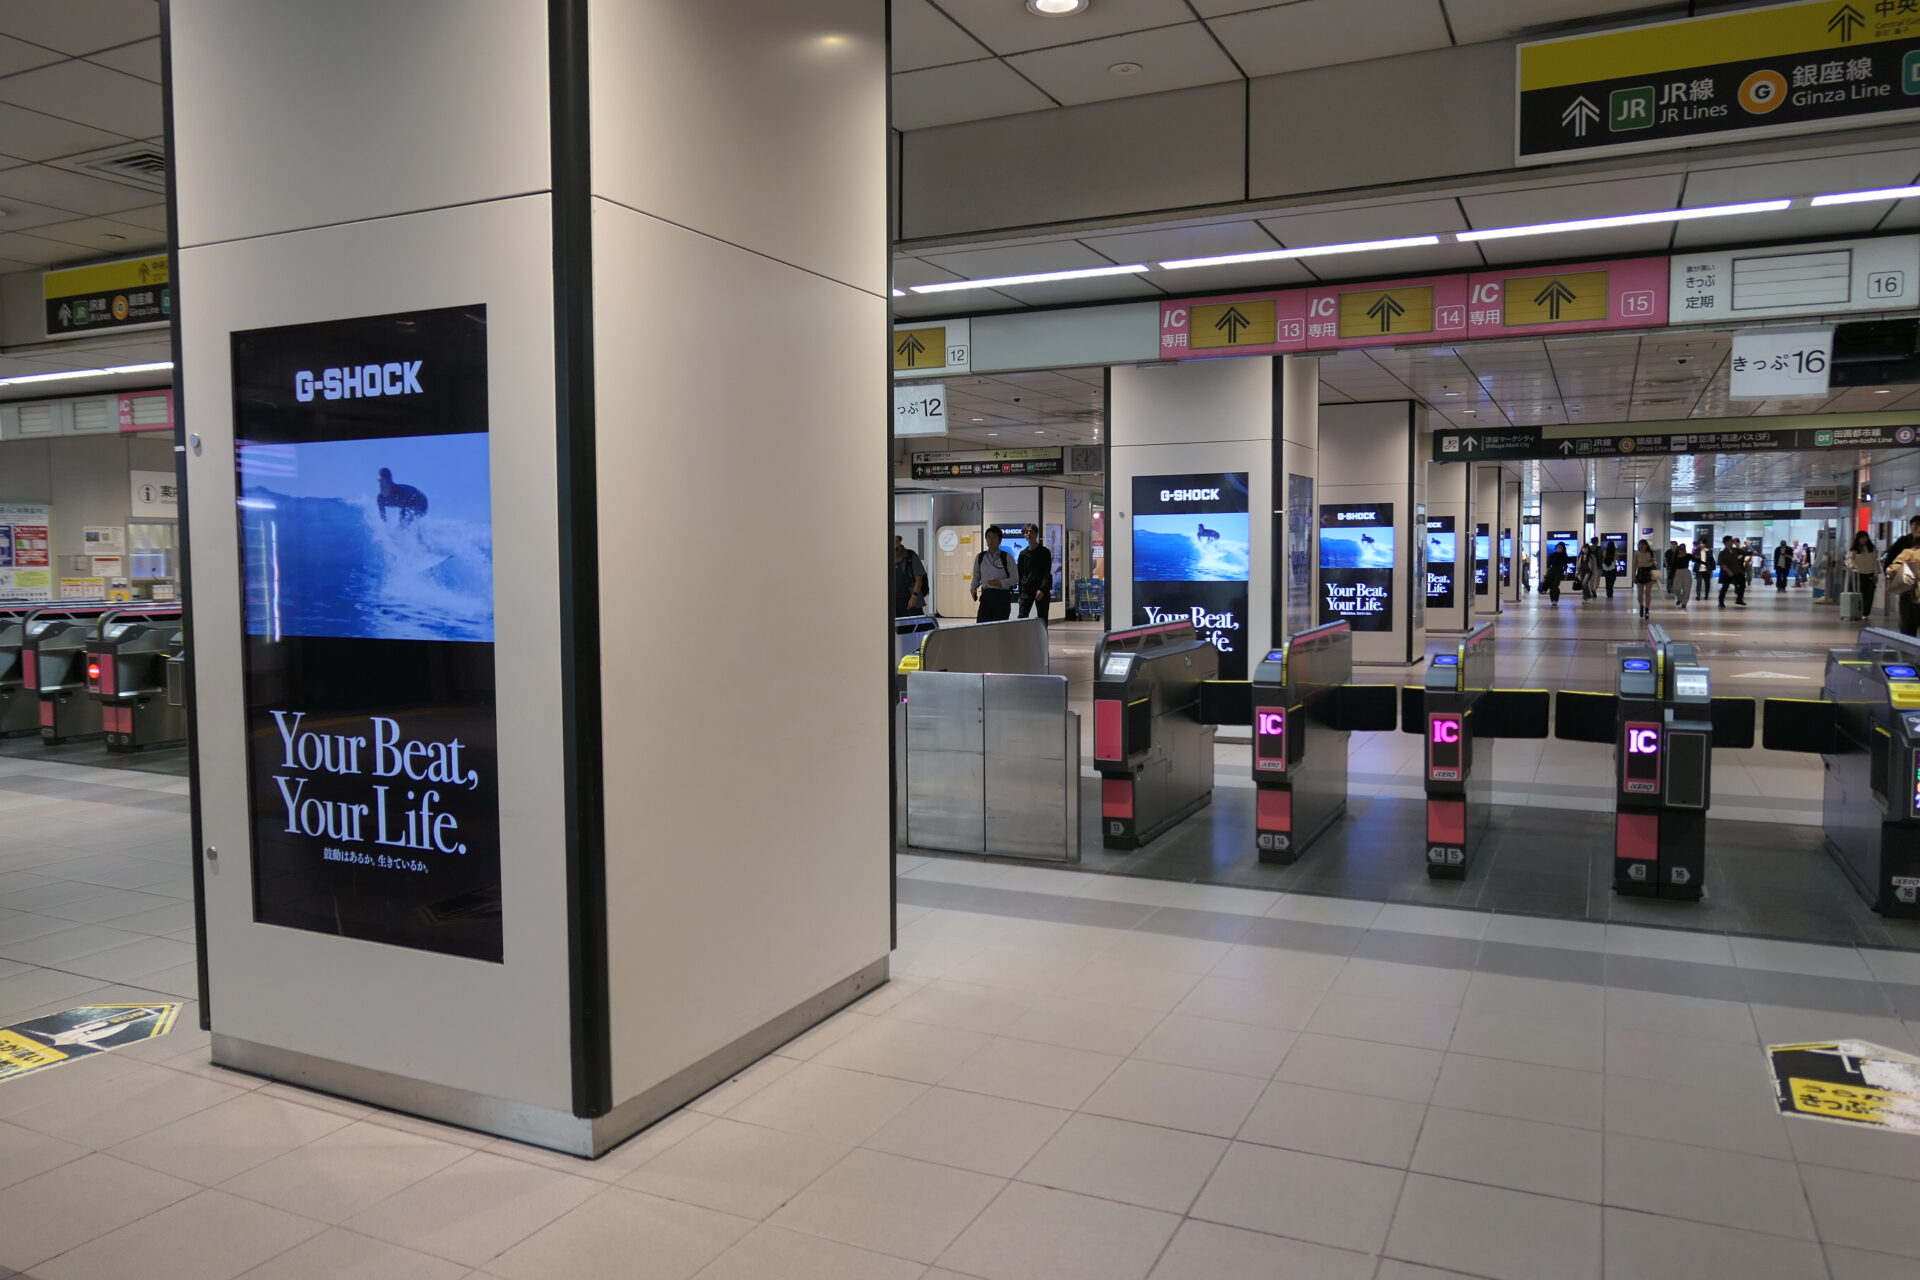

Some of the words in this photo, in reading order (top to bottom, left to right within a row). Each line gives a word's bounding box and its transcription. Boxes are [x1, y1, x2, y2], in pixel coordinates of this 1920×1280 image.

[1792, 57, 1873, 87] 銀座線
[1659, 79, 1714, 105] JR線
[1754, 84, 1772, 99] G
[1792, 88, 1846, 106] Ginza
[1851, 82, 1891, 100] Line
[1616, 99, 1646, 120] JR
[1659, 108, 1678, 124] JR
[1683, 103, 1728, 121] Lines
[1686, 274, 1716, 288] きっぷ
[1874, 276, 1897, 293] 16
[1472, 282, 1500, 304] IC
[1310, 298, 1335, 317] IC
[1627, 296, 1648, 312] 15
[1686, 296, 1714, 310] 定期
[1163, 309, 1186, 328] IC
[1440, 310, 1460, 324] 14
[1469, 309, 1500, 326] 専用
[1282, 324, 1300, 337] 13
[1308, 322, 1336, 338] 専用
[1161, 333, 1187, 348] 専用
[950, 350, 964, 362] 12
[296, 360, 423, 402] G-SHOCK
[896, 402, 919, 414] っぷ
[1578, 443, 1590, 451] JR
[1160, 488, 1220, 502] G-SHOCK
[1326, 582, 1356, 597] Your
[1356, 583, 1387, 598] Beat,
[1326, 598, 1356, 611] Your
[1356, 597, 1383, 611] Life.
[1143, 606, 1190, 624] Your
[1190, 606, 1239, 630] Beat,
[1205, 630, 1234, 652] ife.
[1259, 713, 1282, 735] IC
[1433, 720, 1458, 742] IC
[1628, 729, 1657, 753] IC
[268, 710, 366, 775] Your
[370, 716, 479, 790] Beat,
[272, 775, 369, 842] Your
[372, 785, 466, 855] Life.
[1113, 824, 1120, 832] 13
[1263, 836, 1271, 845] 13
[1434, 849, 1442, 858] 14
[1450, 850, 1458, 860] 15
[1634, 866, 1644, 876] 15
[1675, 870, 1684, 880] 16
[1904, 888, 1913, 897] 16
